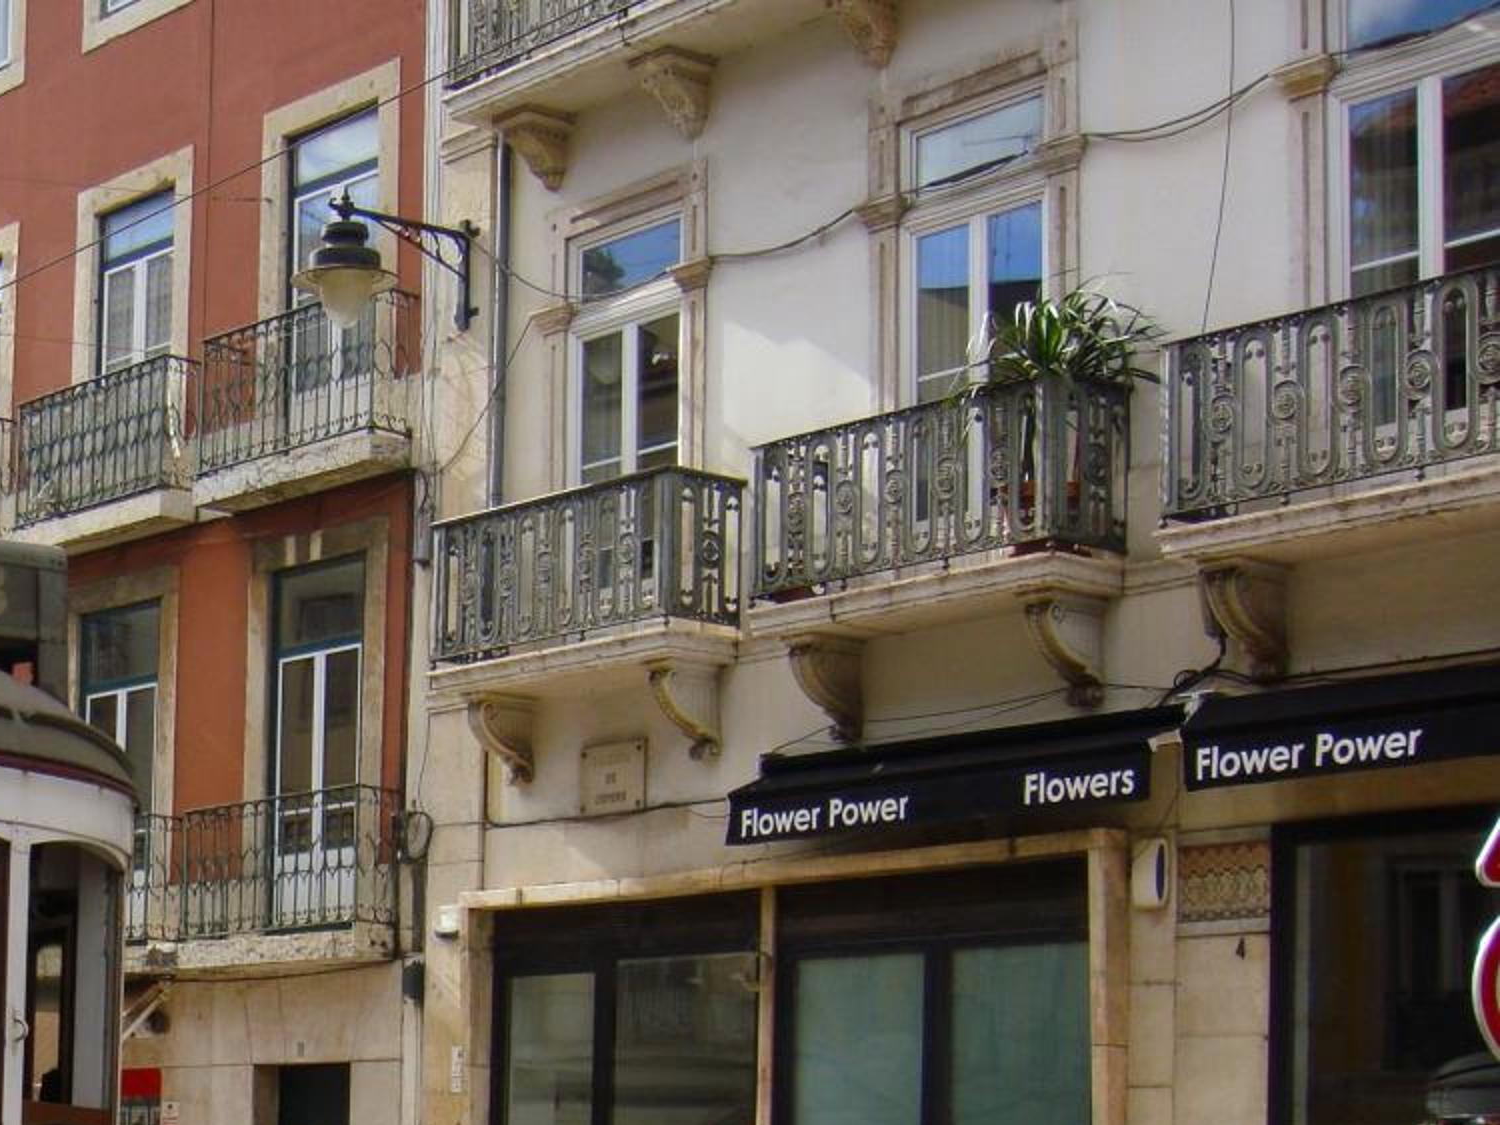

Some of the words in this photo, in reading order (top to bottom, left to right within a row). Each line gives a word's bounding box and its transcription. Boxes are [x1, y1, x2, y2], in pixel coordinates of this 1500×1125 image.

[1196, 743, 1304, 780] Flower
[1315, 728, 1422, 767] Power
[1023, 768, 1134, 806] Flowers
[740, 805, 820, 838] Flower
[829, 795, 909, 828] Power
